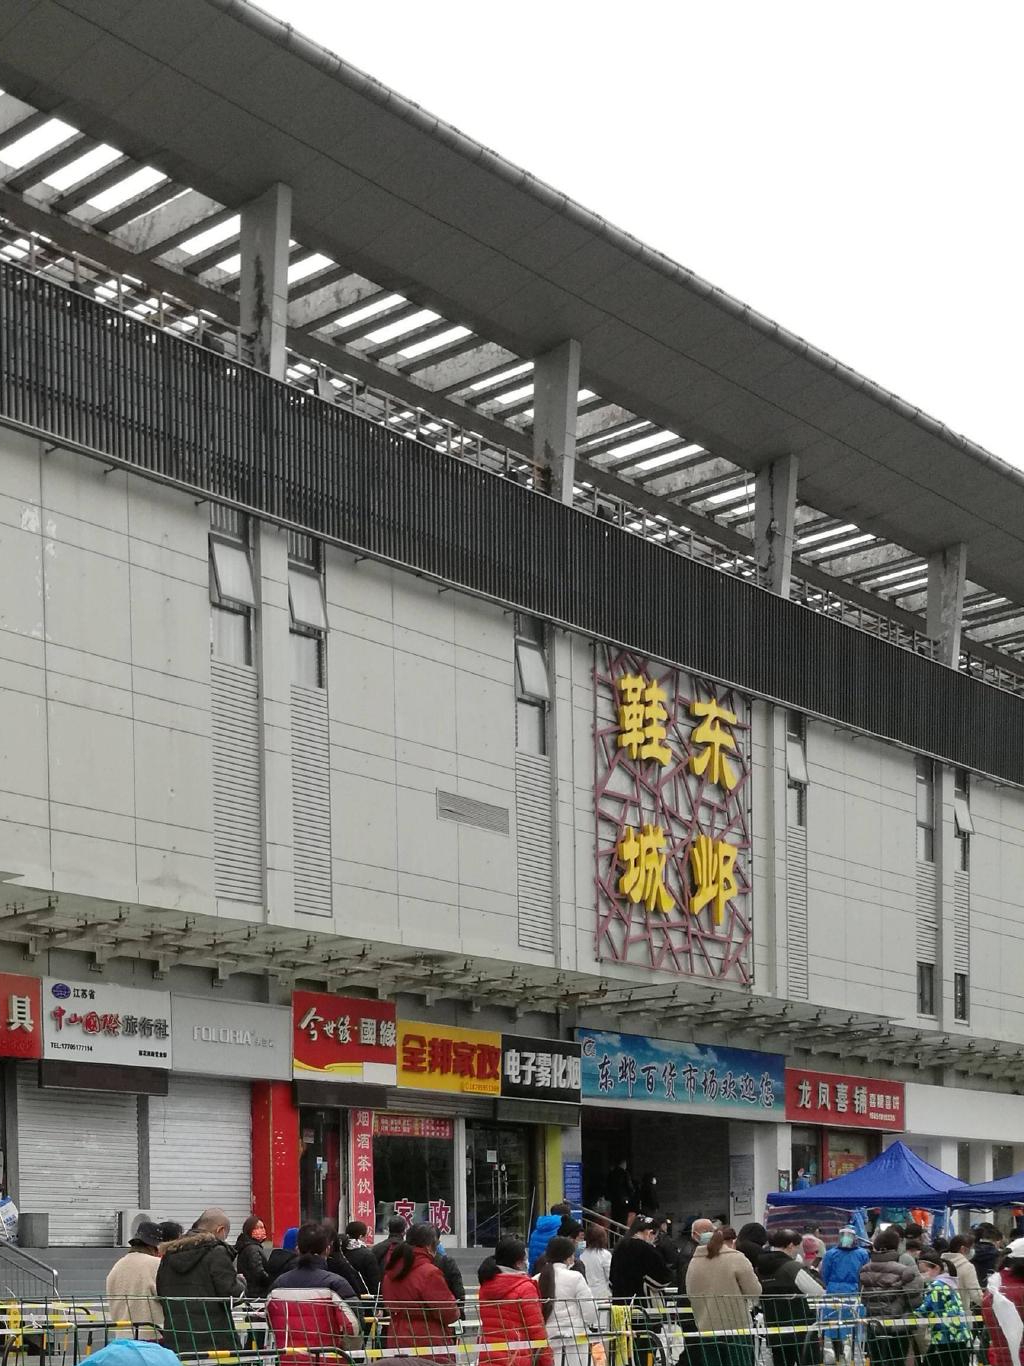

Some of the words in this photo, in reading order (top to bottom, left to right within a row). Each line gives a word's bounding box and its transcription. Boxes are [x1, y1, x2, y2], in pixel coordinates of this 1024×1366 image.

[618, 673, 675, 914] 鞋城
[72, 988, 96, 1000] 江苏省
[402, 1033, 500, 1081] 全邦家政
[503, 1048, 581, 1090] 电子雾化烟
[796, 1079, 868, 1115] 龙凤喜铺
